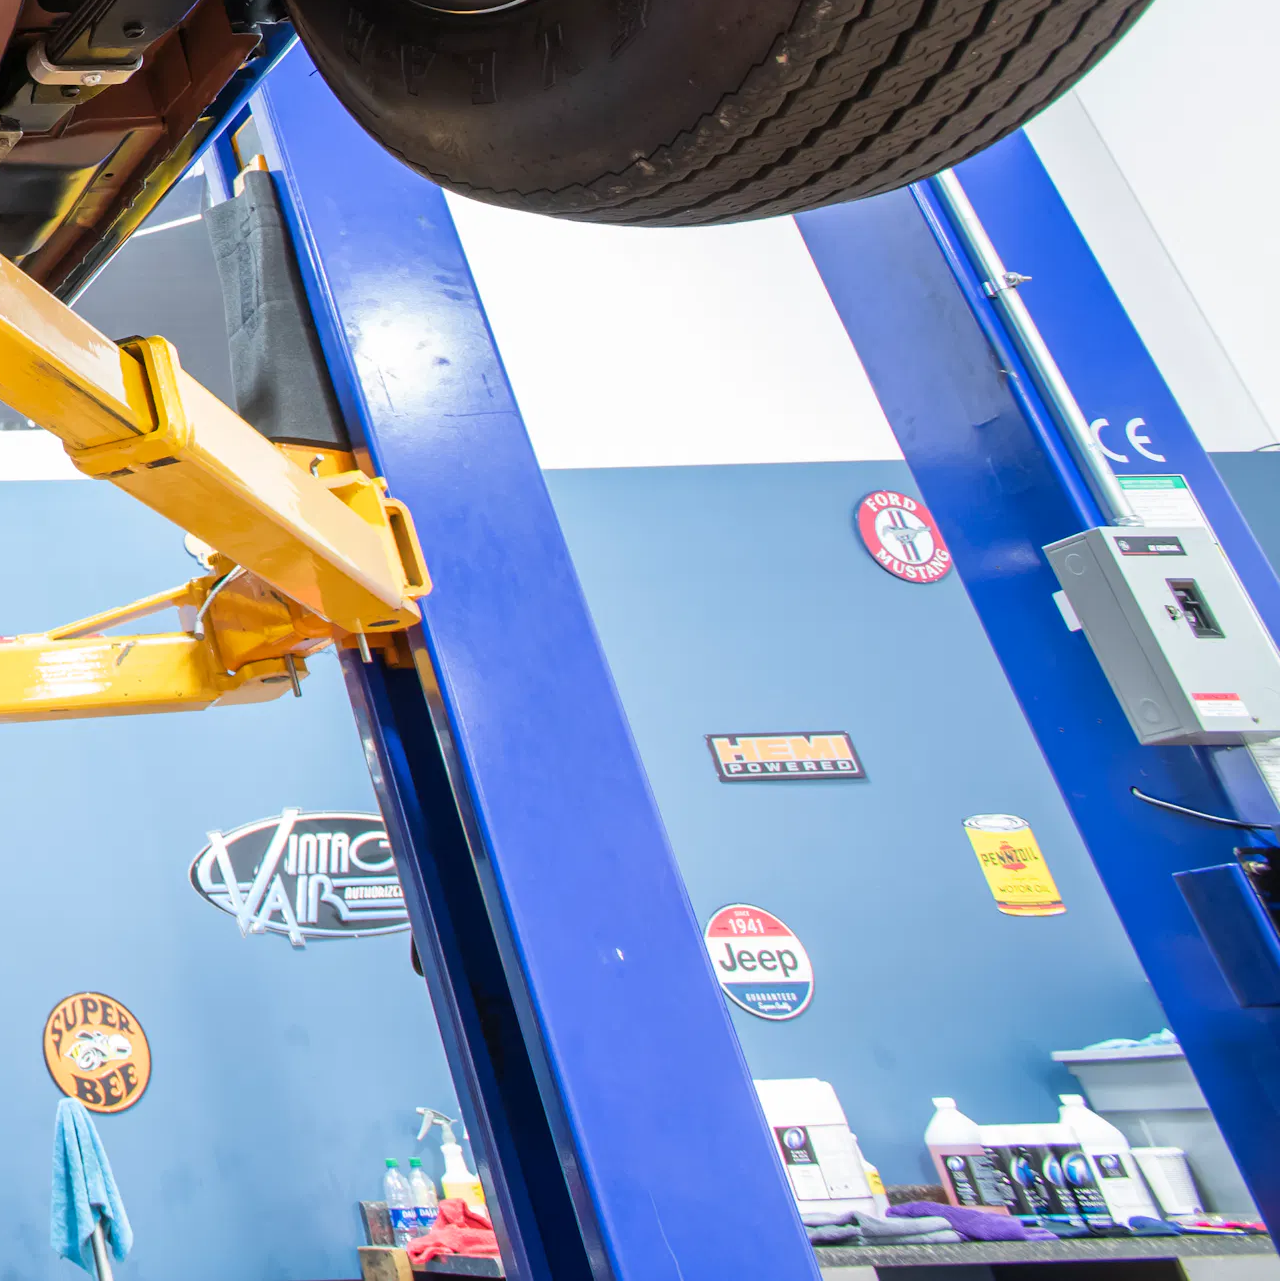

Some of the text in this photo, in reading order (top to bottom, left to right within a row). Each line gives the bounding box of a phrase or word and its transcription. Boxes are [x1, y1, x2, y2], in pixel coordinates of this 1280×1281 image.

[865, 493, 917, 512] FORD
[876, 548, 949, 580] MUSTANG
[712, 735, 853, 762] HEMI
[728, 760, 852, 774] POWERED
[980, 846, 1039, 867] PENNZOIL
[206, 808, 394, 938] VINTAG
[344, 886, 403, 900] AUTHORIZE
[250, 871, 350, 946] AIR
[728, 918, 765, 934] 1941
[719, 942, 799, 978] Jeep
[745, 992, 798, 1002] GUARANTEED
[50, 997, 137, 1063] SUPER
[70, 1061, 139, 1106] BEE
